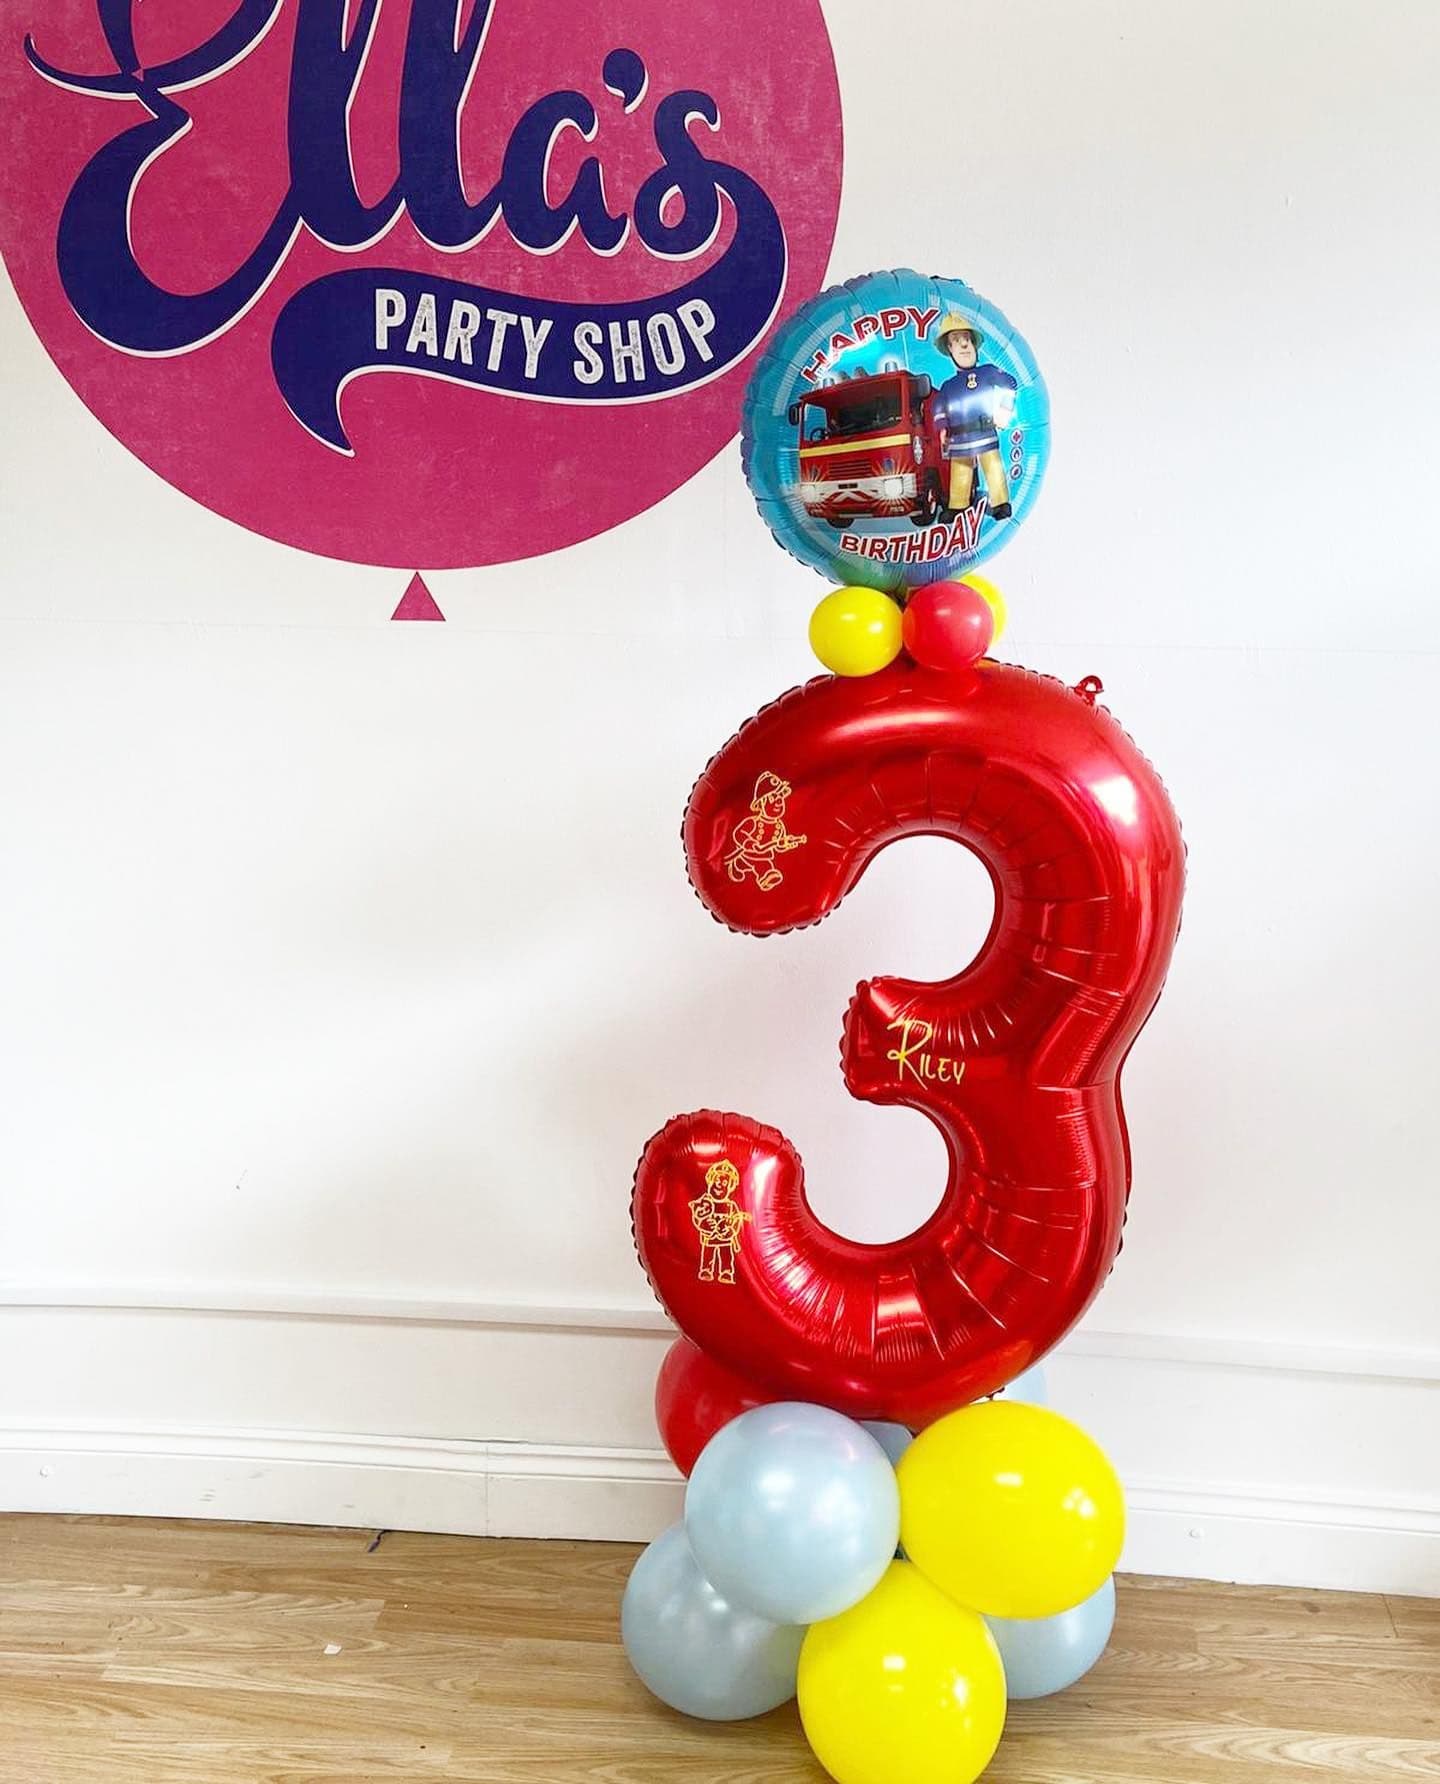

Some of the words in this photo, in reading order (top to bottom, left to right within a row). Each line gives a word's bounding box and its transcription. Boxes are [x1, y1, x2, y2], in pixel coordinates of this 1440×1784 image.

[375, 289, 553, 379] PARTY
[574, 299, 715, 385] SHOP
[803, 307, 939, 383] HAPPY
[840, 498, 987, 563] BIRTHDAY
